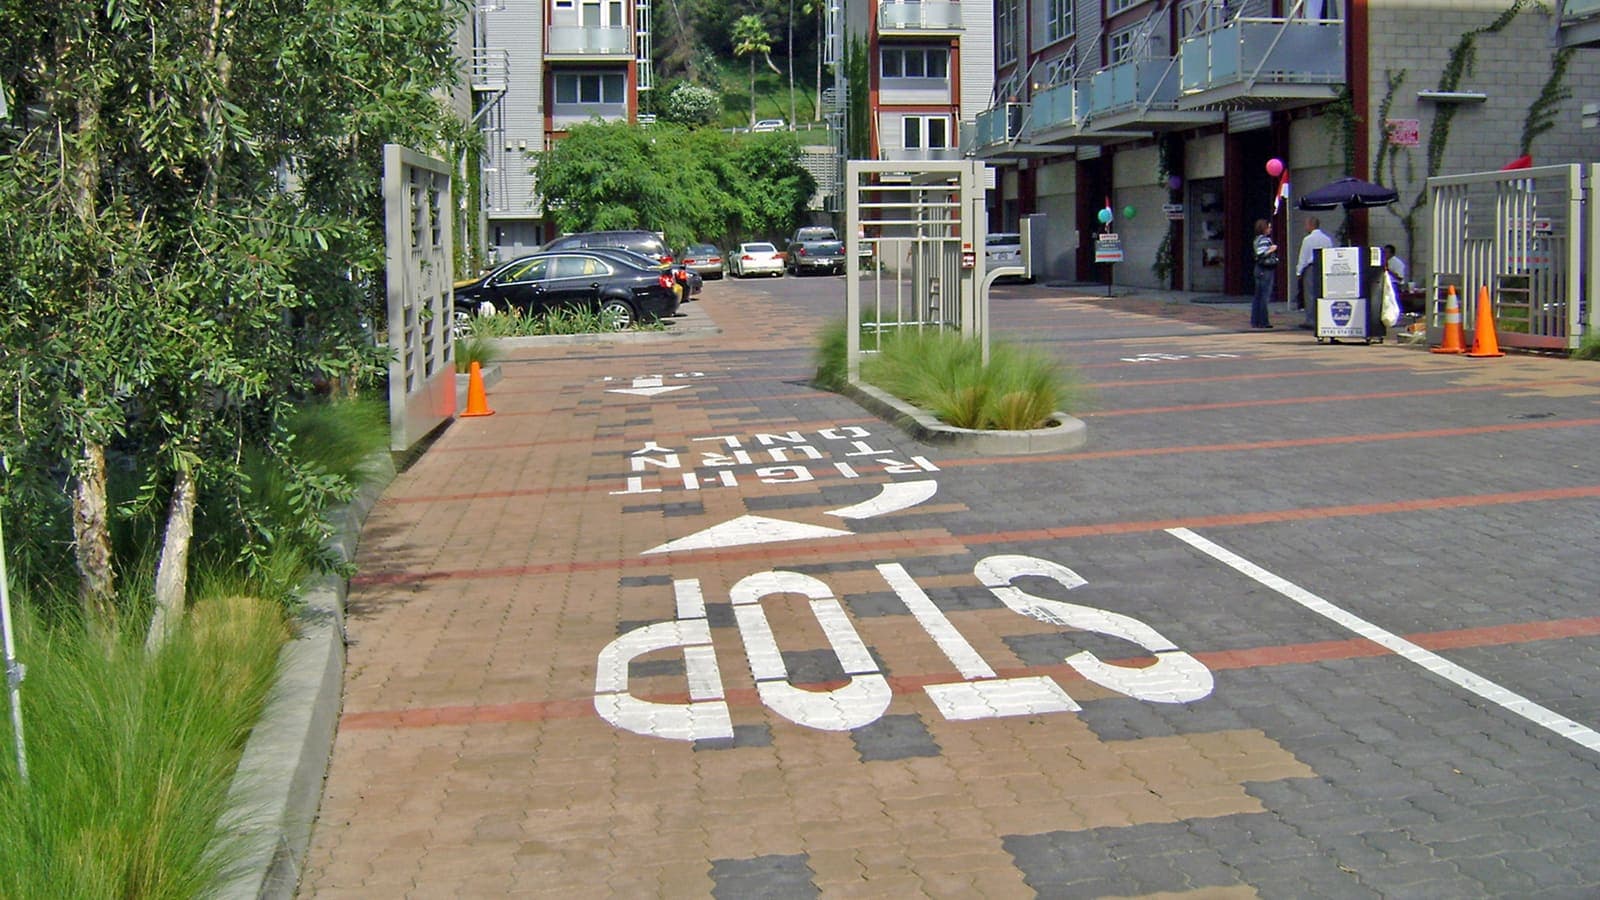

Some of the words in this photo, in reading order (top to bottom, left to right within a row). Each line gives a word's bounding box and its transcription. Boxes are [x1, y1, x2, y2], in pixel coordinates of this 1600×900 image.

[630, 440, 895, 472] TURN
[632, 426, 872, 455] ONLY
[608, 455, 941, 496] RIGHT
[594, 554, 1215, 742] STOP
